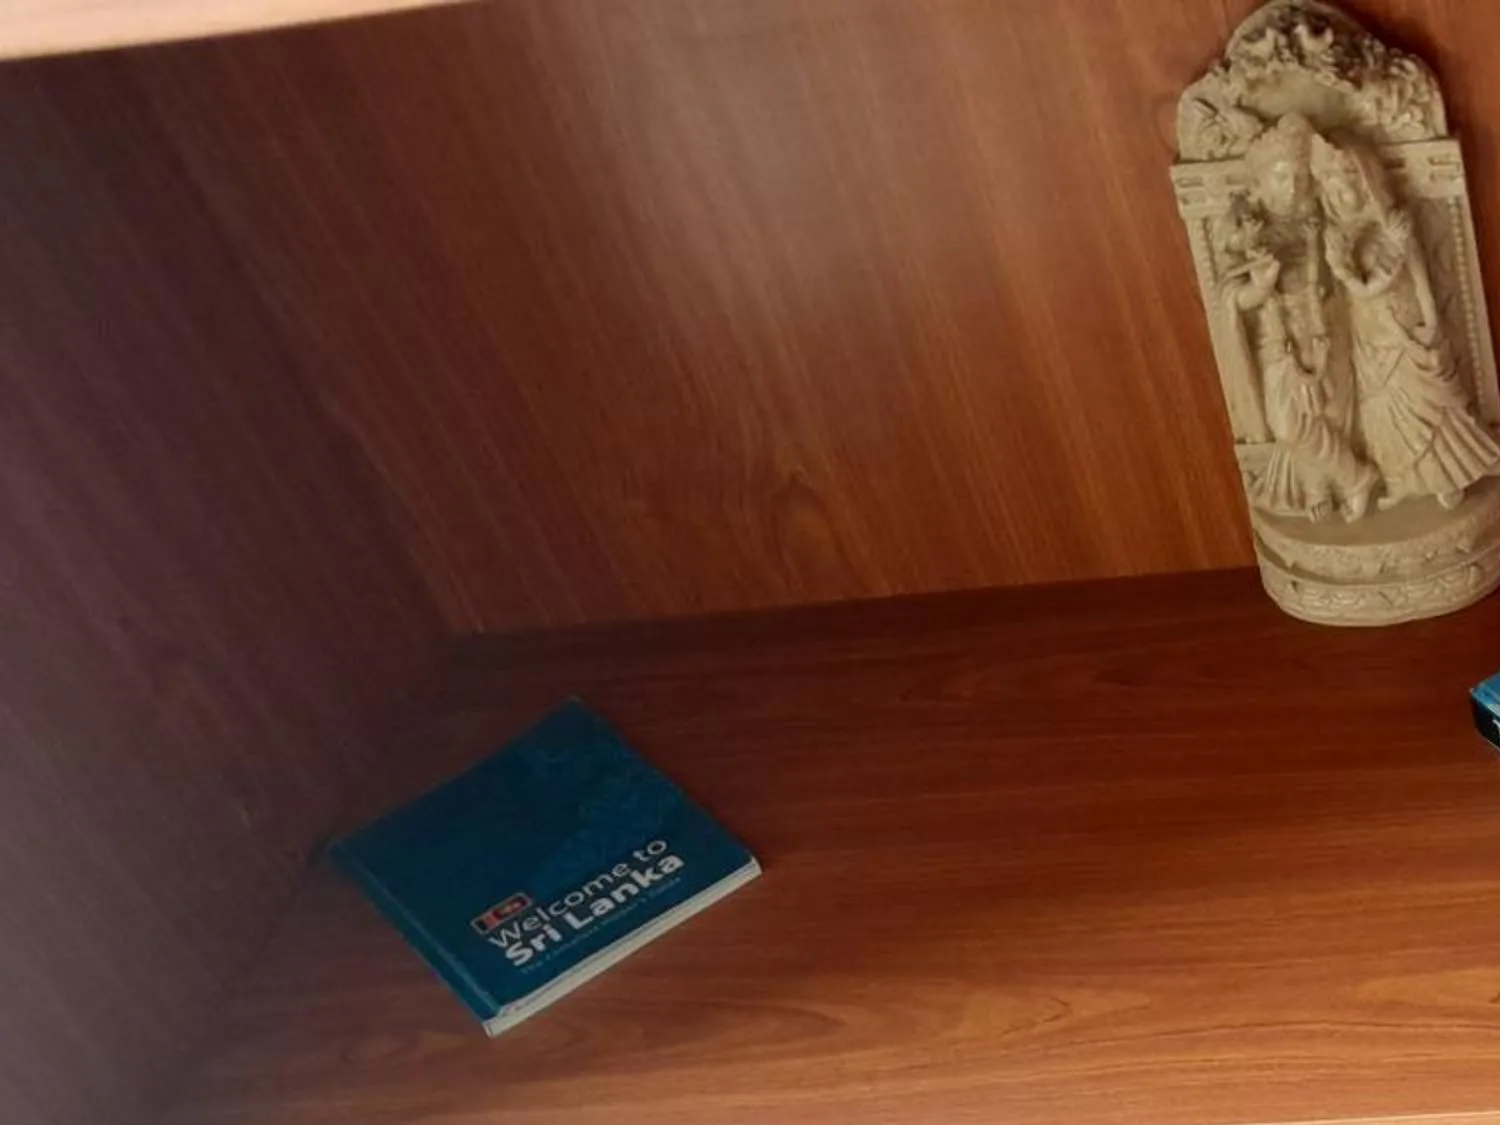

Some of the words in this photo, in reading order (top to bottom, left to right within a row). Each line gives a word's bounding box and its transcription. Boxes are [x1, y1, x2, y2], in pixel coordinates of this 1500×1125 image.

[488, 861, 631, 949] Welcome
[633, 839, 668, 864] to
[505, 921, 562, 967] Sri
[569, 854, 685, 930] Lanka
